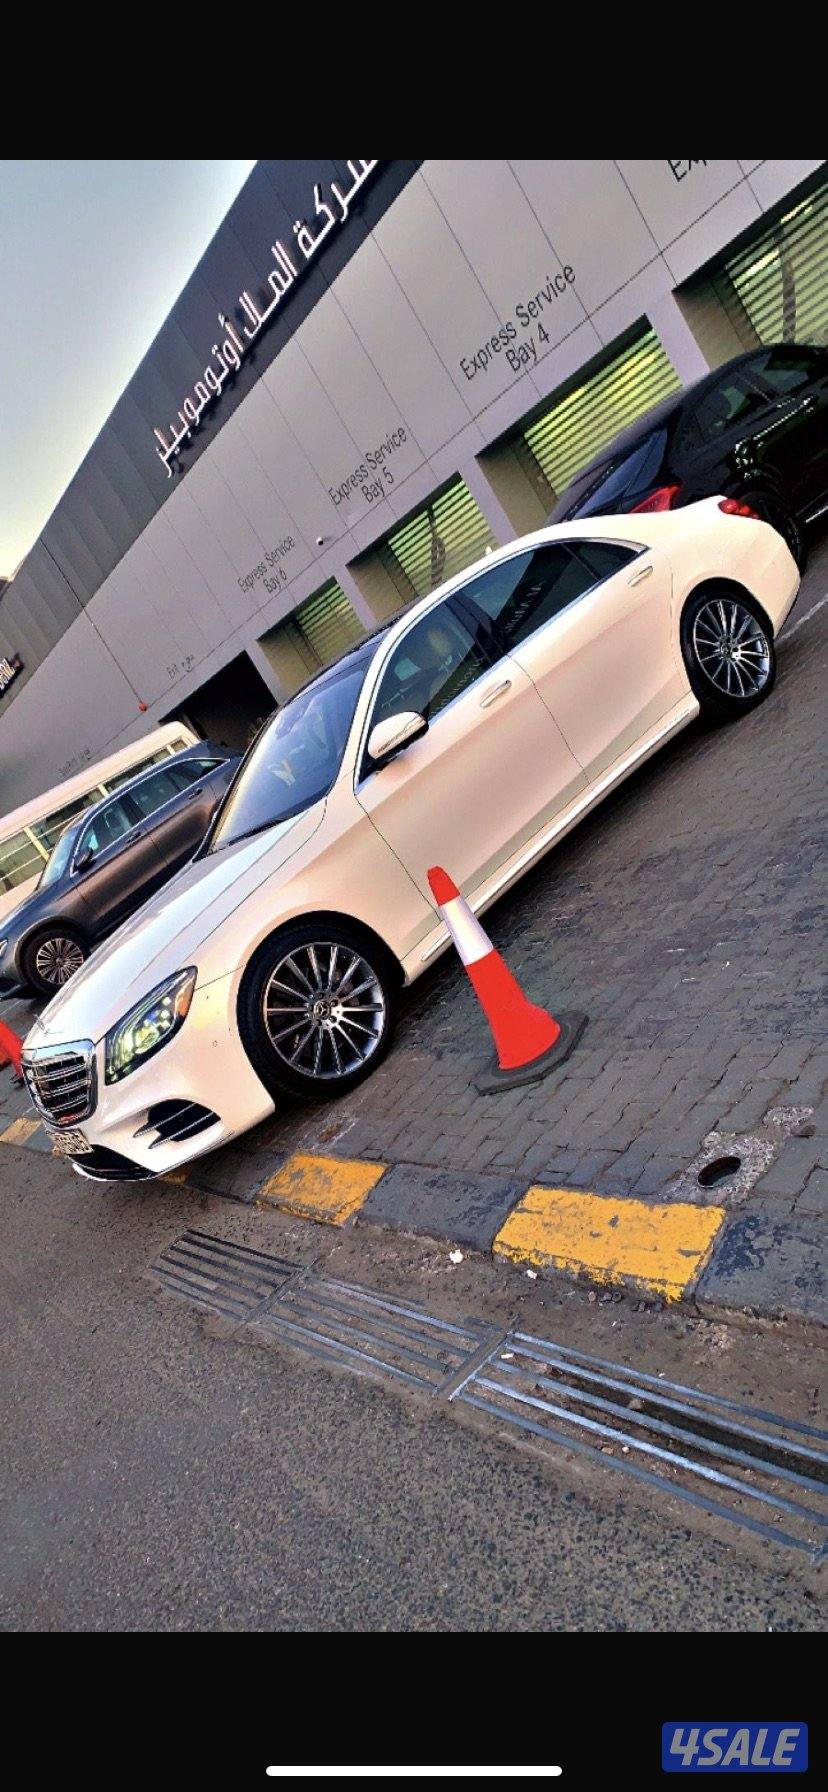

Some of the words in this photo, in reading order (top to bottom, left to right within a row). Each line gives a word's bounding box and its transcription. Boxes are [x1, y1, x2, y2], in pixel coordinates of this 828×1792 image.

[460, 322, 517, 380] Express
[516, 265, 576, 327] Service
[505, 337, 539, 371] Bay
[537, 322, 550, 343] 4
[328, 465, 369, 505] Express
[365, 427, 407, 470] Service
[361, 478, 385, 503] Bay
[382, 466, 394, 484] 5
[238, 562, 267, 593] Express
[264, 536, 295, 567] Service
[263, 576, 282, 593] Bay
